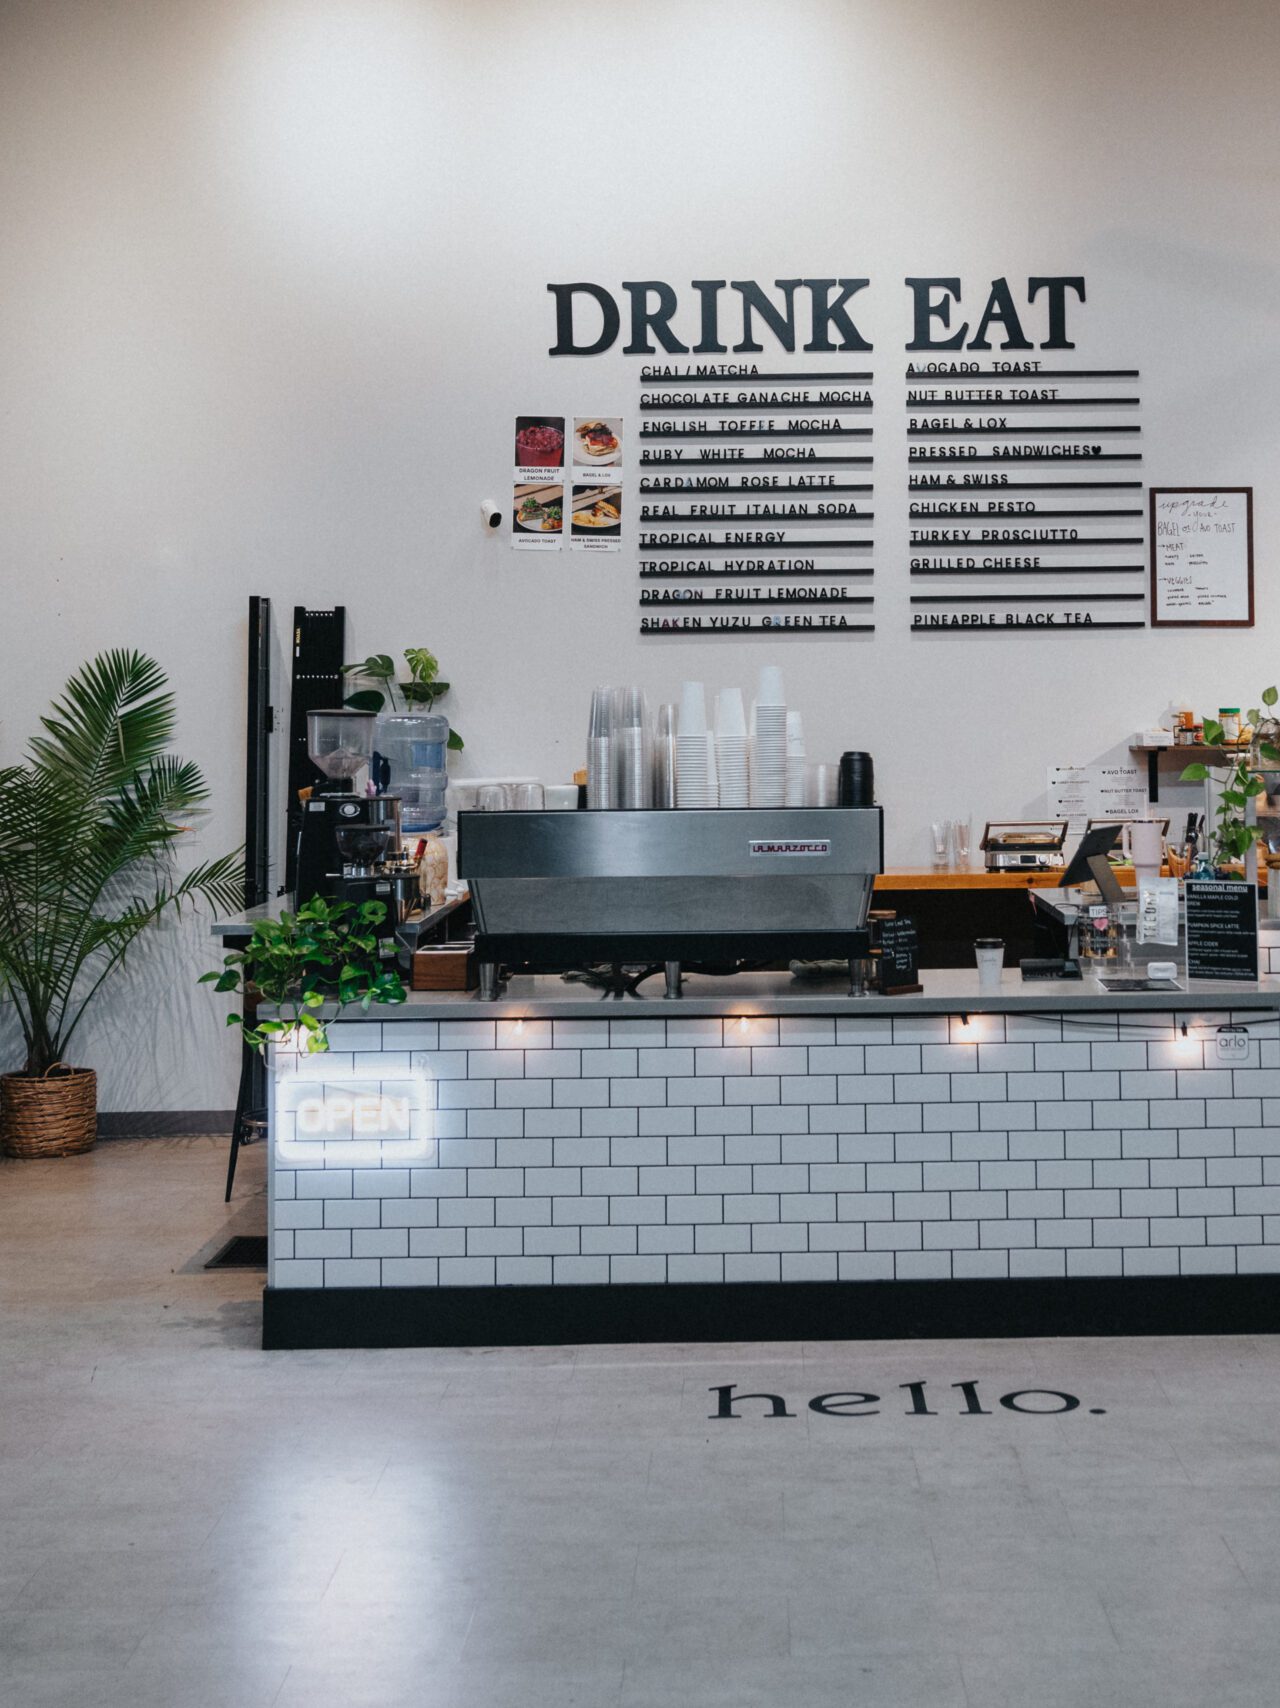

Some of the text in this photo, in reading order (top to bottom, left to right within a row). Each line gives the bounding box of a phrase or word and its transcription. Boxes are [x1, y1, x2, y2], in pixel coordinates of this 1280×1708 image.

[547, 278, 874, 355] DRINK
[905, 276, 1087, 351] EAT
[641, 365, 678, 376] CHAI
[696, 364, 759, 376] MATCHA
[907, 361, 1042, 373] AVOCADO TOAST
[640, 391, 872, 404] CHOCOLATE GANACHE MOCHA
[908, 389, 1059, 401] NUT BUTTER TOAST
[643, 419, 842, 432] ENGLISH TOFFEE MOCHA
[910, 417, 1007, 429] BAGEL & LOX
[642, 447, 817, 461] RUBY WHITE MOCHA
[909, 446, 977, 457] PRESSED
[640, 475, 836, 488] CARDAMOM ROSE LATTE
[909, 474, 1009, 485] HAM & SWISS
[642, 503, 857, 516] REAL FRUIT ITALIAN SODA
[910, 501, 1036, 513] CHICKEN PESTO
[1158, 495, 1229, 517] upgrade
[910, 530, 971, 541] TURKEY
[1157, 521, 1181, 537] BAGEL
[640, 532, 786, 544] TROPICAL ENERGY
[640, 560, 815, 572] TROPICAL HYDRATION
[910, 557, 1041, 569] GRILLED CHEESE
[641, 587, 848, 600] DRAGON FRUIT LEMONADE
[641, 615, 848, 628] SHAKEN YUZU GREEN TEA
[914, 612, 1093, 625] PINEAPPLE BLACK TEA
[1192, 884, 1248, 893] seasonal menu
[1219, 1035, 1246, 1048] arlo
[298, 1097, 409, 1132] OPEN
[708, 1380, 1108, 1420] hello.
